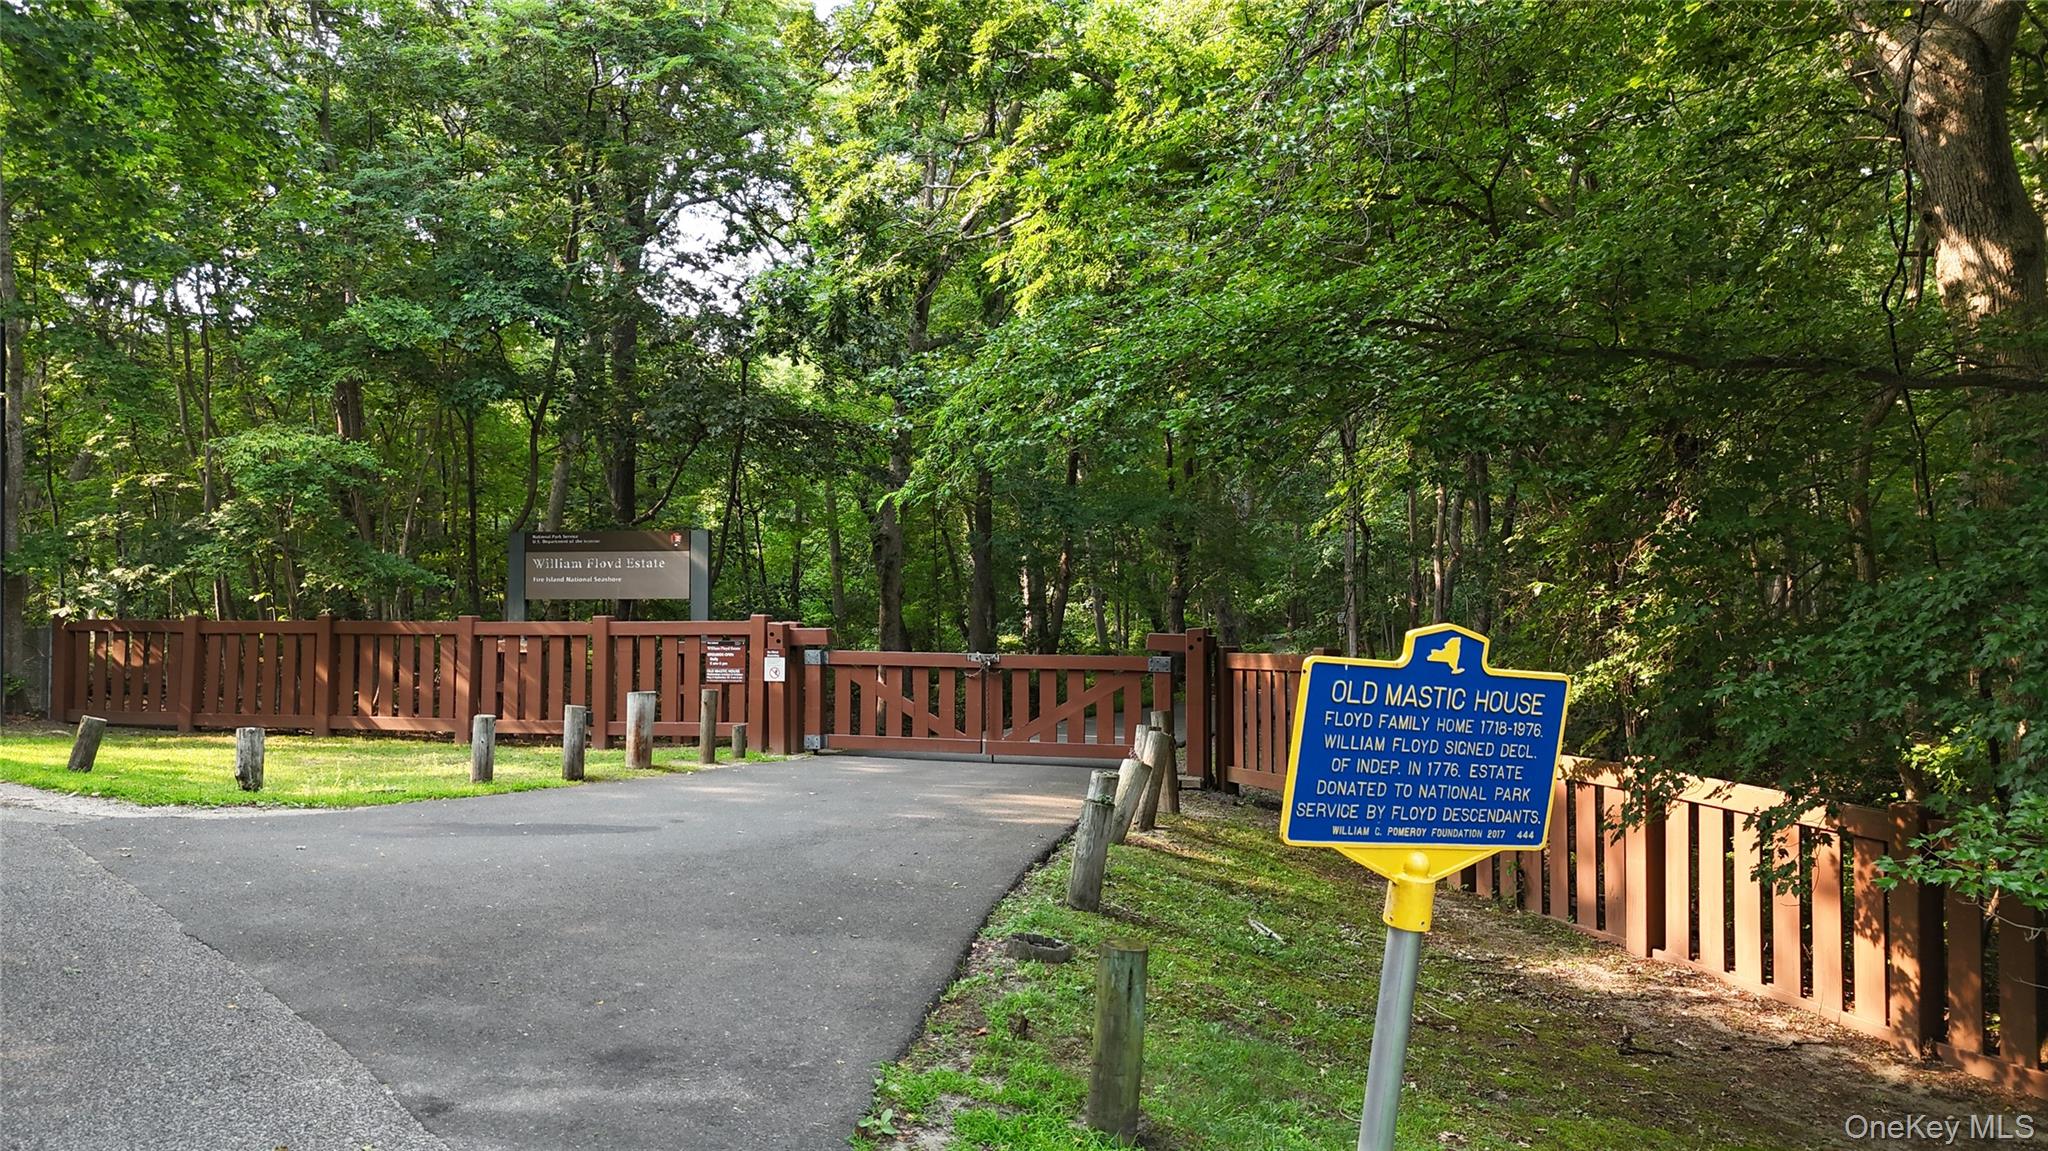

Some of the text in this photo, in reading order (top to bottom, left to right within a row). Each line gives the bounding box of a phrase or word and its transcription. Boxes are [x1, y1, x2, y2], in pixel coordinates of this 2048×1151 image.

[533, 558, 582, 568] William
[626, 558, 665, 568] Estate
[1331, 680, 1546, 716] OLD MASTIC HOUSE
[1325, 711, 1543, 738] FLOYD FAMILY HOME 1718-1976.
[1324, 734, 1537, 759] WILLIAM FLOYD SIGNED DECL.
[1331, 758, 1524, 780] OF INDEP. IN 1776. ESTATE
[1317, 780, 1531, 802] DONATED TO NATIONAL PARK
[1296, 803, 1541, 824] SERVICE BY FLOYD DESCENDANTS.
[1332, 826, 1370, 836] WILLIAM
[1387, 827, 1427, 837] POMEROY
[1431, 828, 1482, 838] FOUNDATION
[1487, 830, 1505, 839] 2017
[1516, 830, 1535, 839] 444
